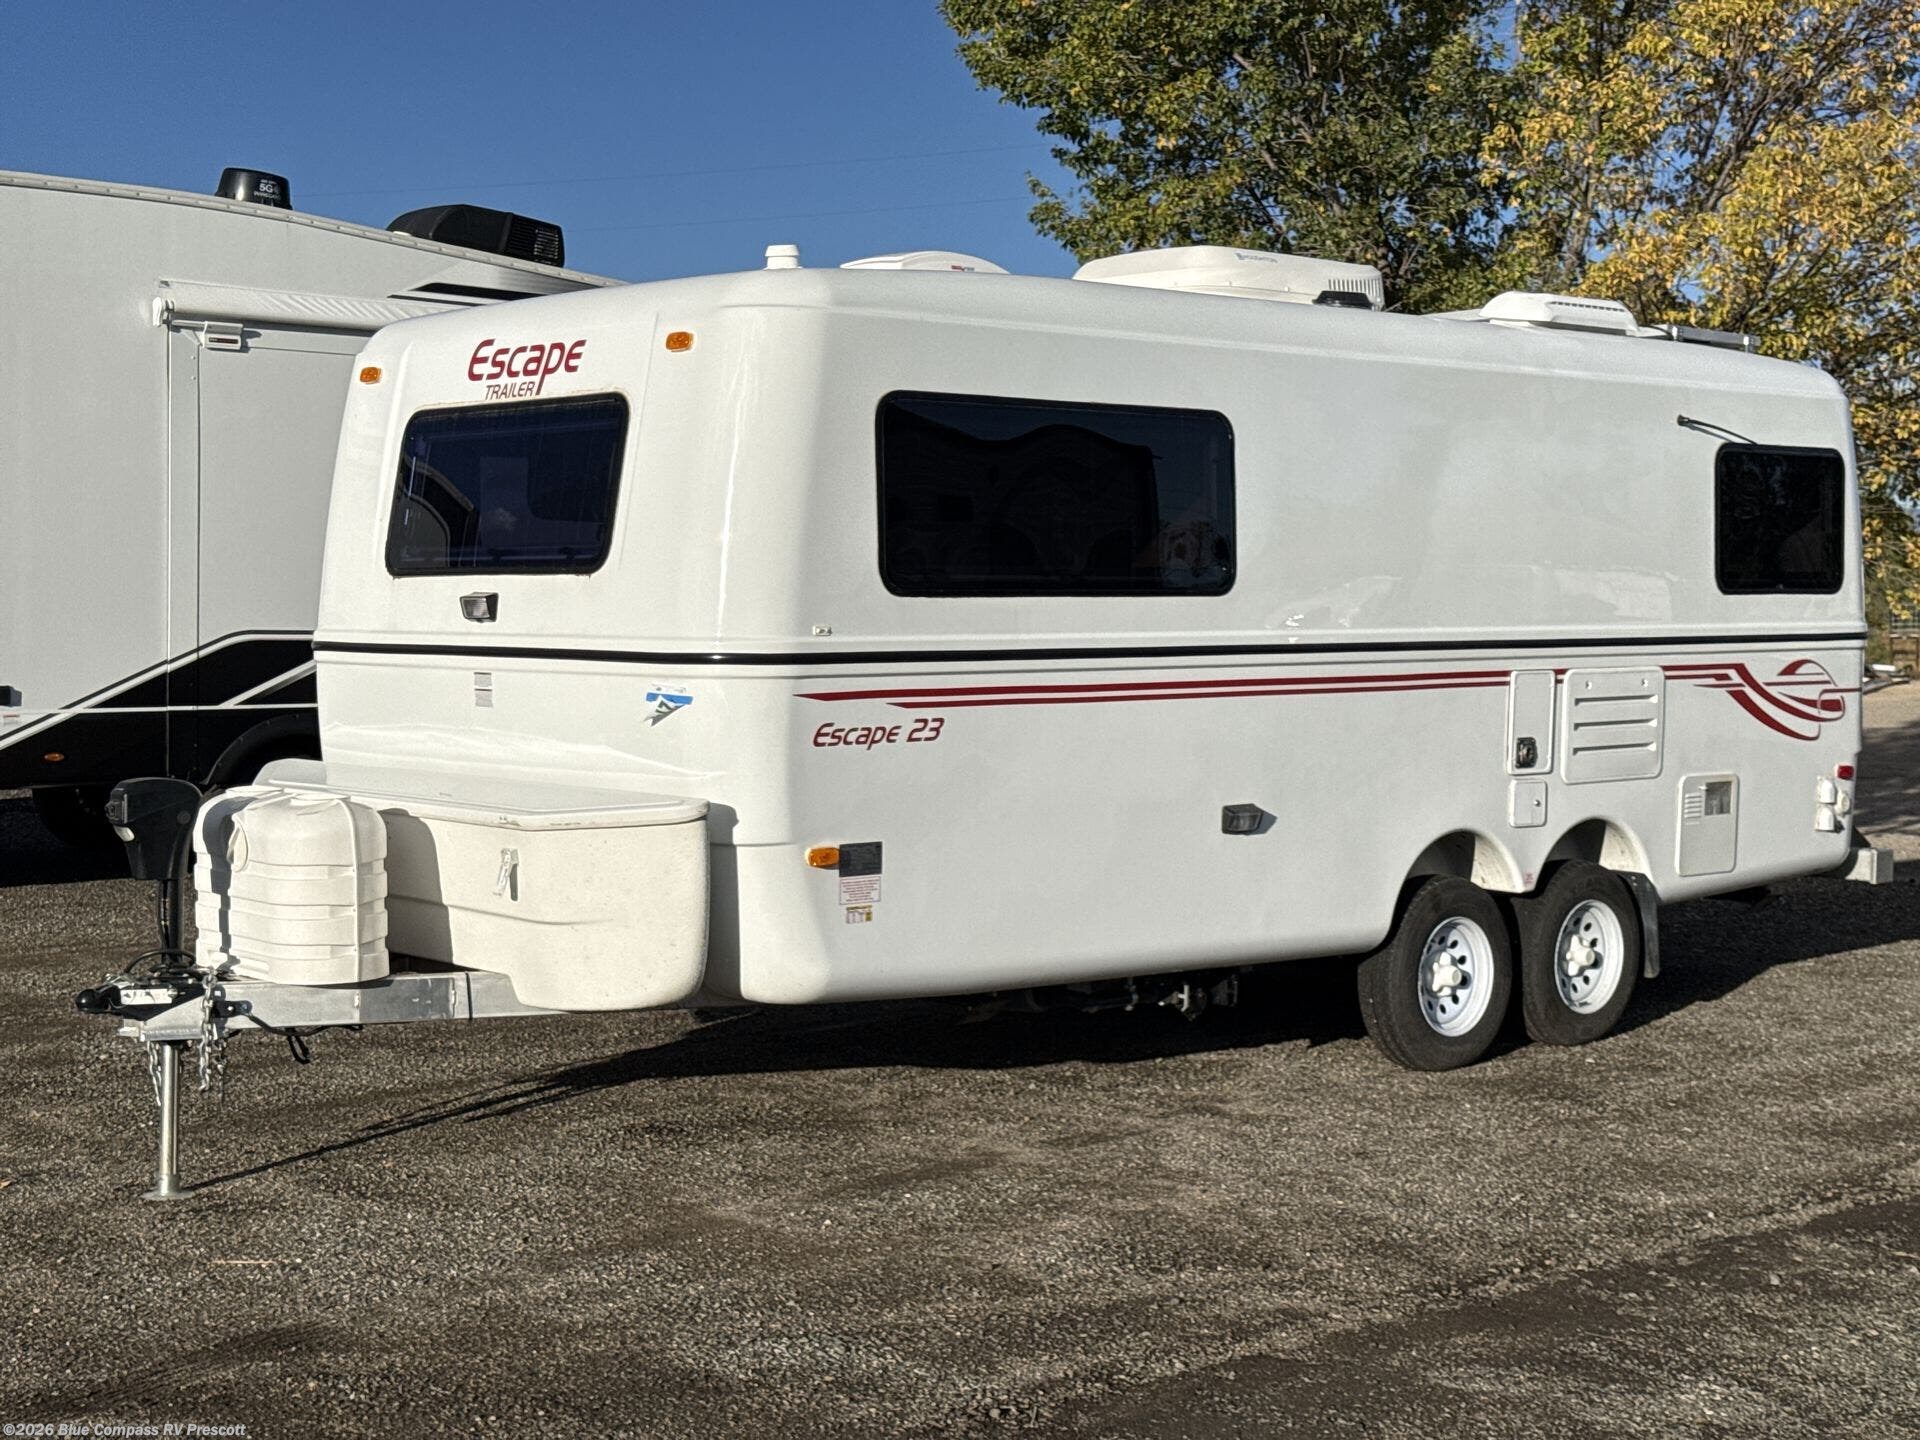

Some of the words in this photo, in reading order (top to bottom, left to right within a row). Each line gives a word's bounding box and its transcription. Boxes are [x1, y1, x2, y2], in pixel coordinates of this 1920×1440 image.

[468, 338, 587, 395] Escape
[485, 381, 536, 400] TRAILER
[813, 722, 902, 751] Escape
[906, 717, 945, 743] 23
